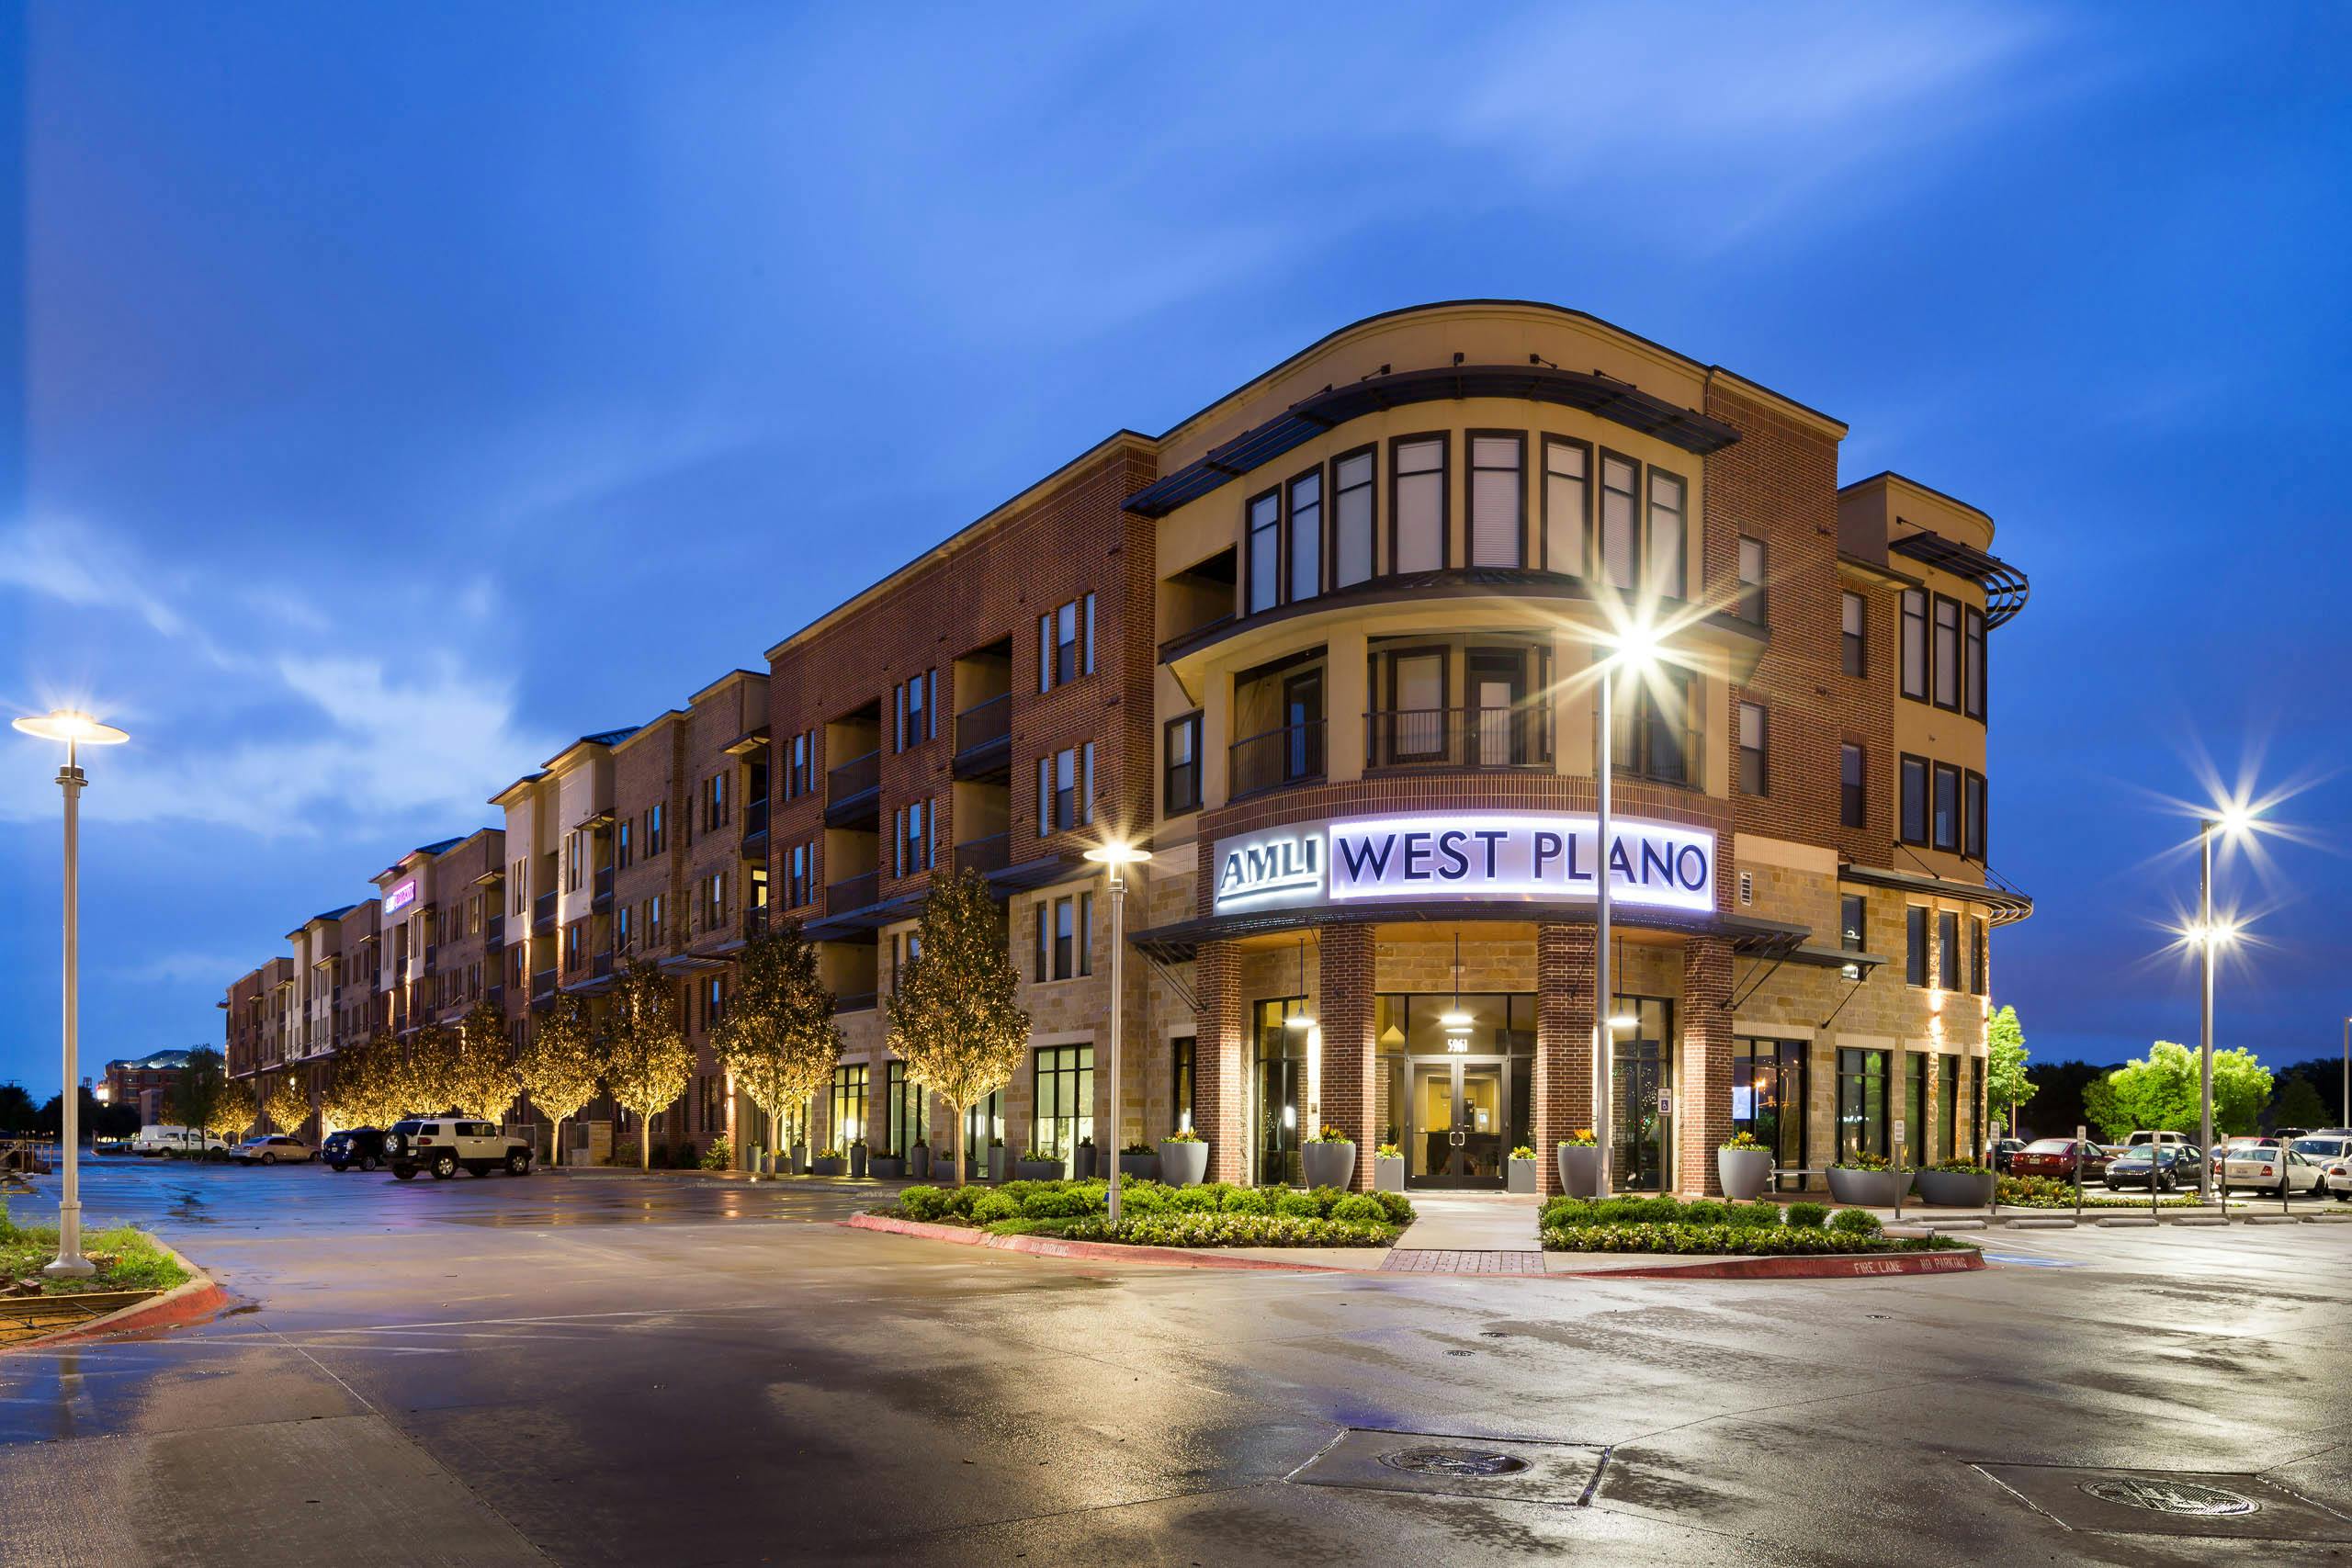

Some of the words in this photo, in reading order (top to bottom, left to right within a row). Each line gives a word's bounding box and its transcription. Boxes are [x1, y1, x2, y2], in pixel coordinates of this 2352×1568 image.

[1220, 838, 1317, 889] AMLI
[1338, 830, 1509, 883] WEST
[1534, 831, 1708, 892] PLANO
[1040, 1243, 1069, 1257] PARKING
[1853, 1261, 1877, 1274] FIRE
[1878, 1259, 1904, 1273] LANE
[1919, 1258, 1933, 1270] NO
[1934, 1257, 1968, 1269] PARKING
